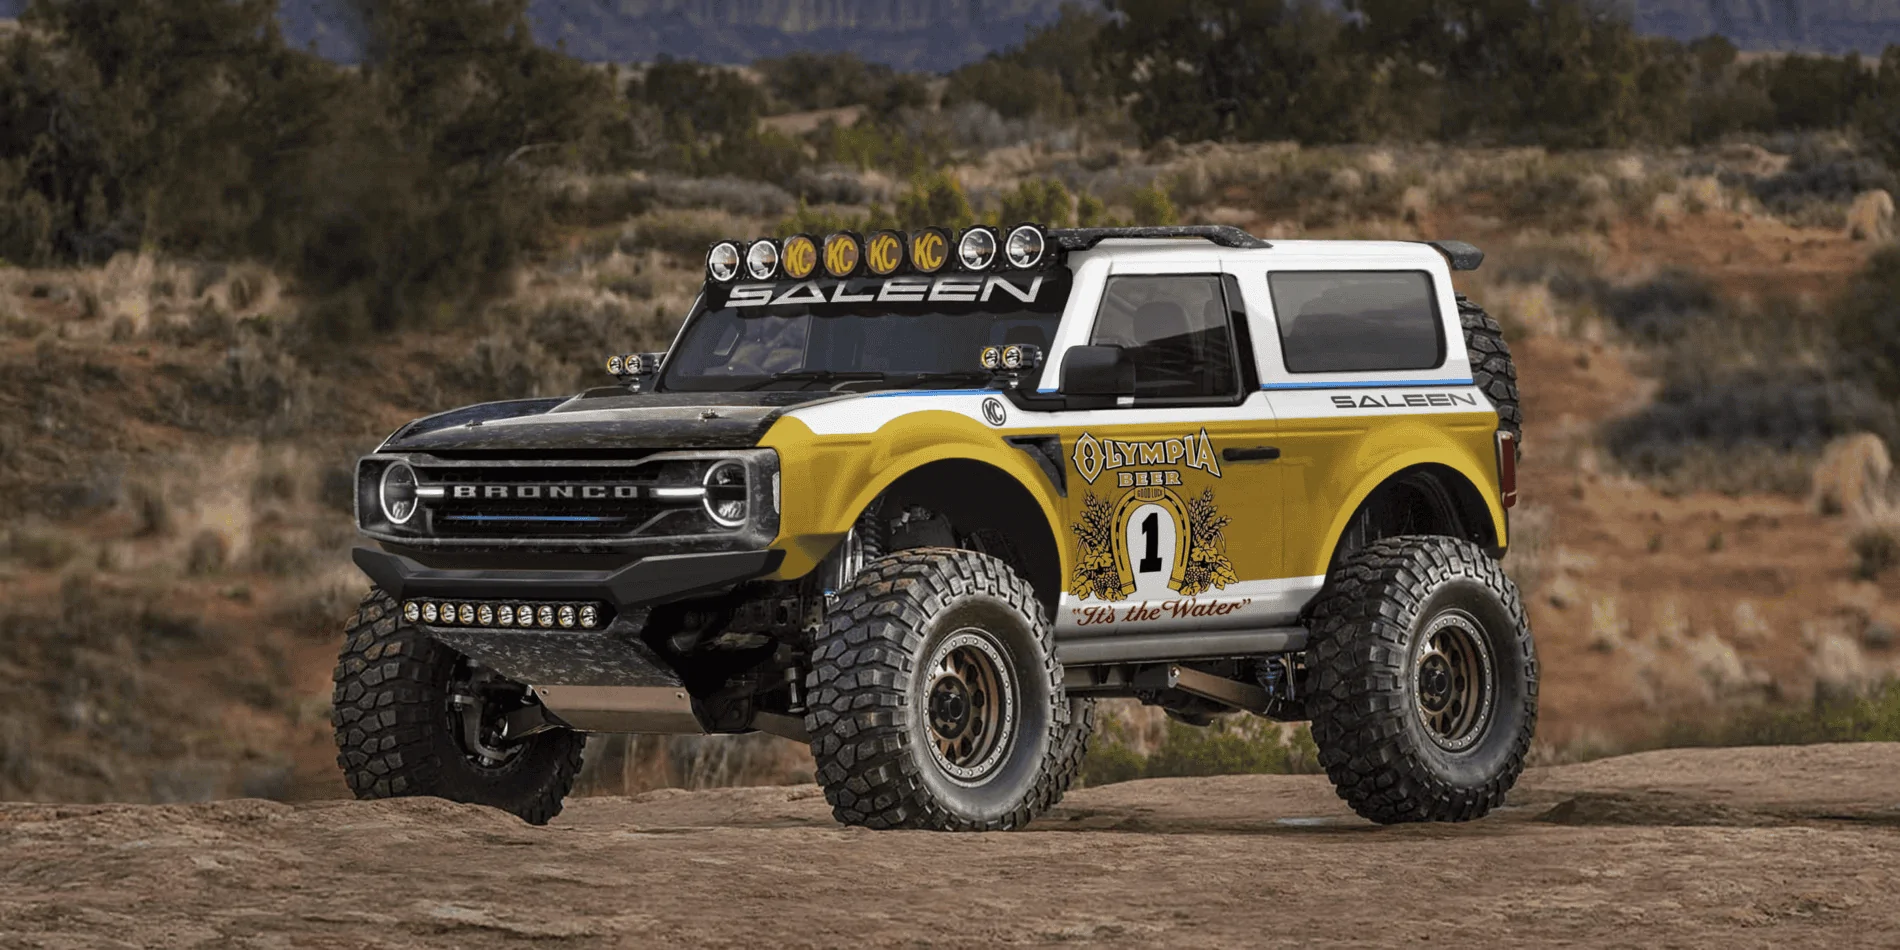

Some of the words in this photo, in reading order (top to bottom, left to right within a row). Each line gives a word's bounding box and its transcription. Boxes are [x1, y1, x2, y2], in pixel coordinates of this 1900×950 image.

[786, 240, 813, 275] KC
[827, 238, 854, 273] KC
[870, 235, 898, 271] KC
[914, 233, 943, 270] KC
[724, 276, 1044, 308] SALEEN
[985, 400, 1003, 423] KC
[1330, 393, 1478, 409] SALEEN
[1073, 427, 1221, 485] OLYMPIA
[454, 486, 638, 498] BRONCO
[1117, 471, 1182, 487] BEER
[1139, 512, 1162, 573] 1
[1121, 601, 1161, 622] the
